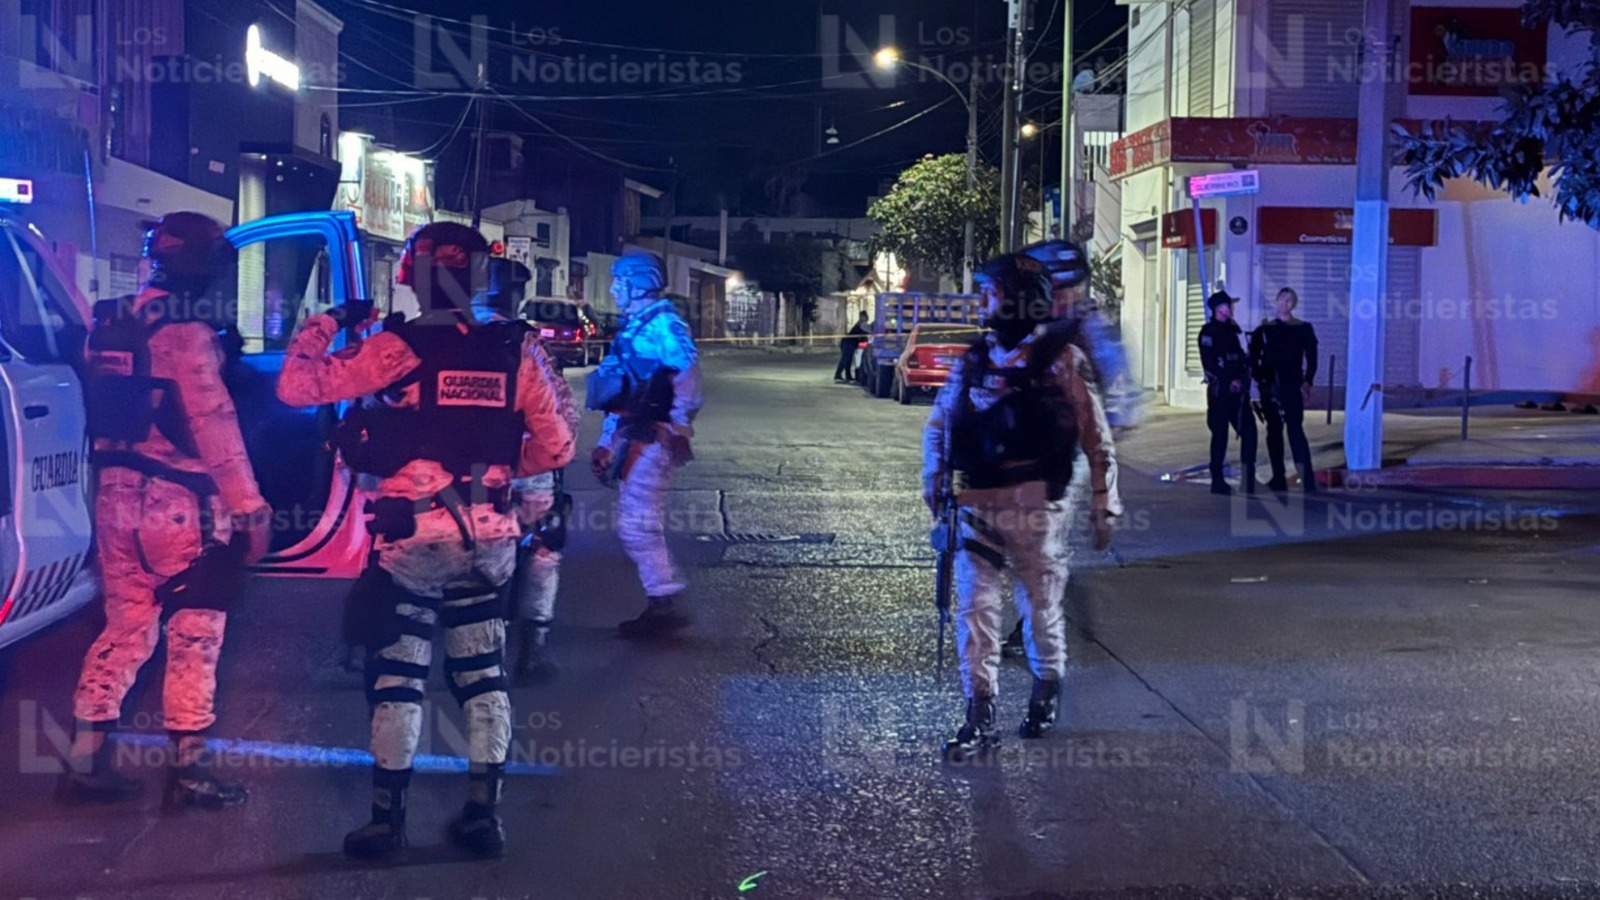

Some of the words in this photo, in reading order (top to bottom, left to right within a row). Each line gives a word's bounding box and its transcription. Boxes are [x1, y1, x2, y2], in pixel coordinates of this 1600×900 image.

[443, 375, 502, 388] GUARDIA
[440, 388, 504, 402] NACIONAL
[31, 449, 79, 492] GUARDIA
